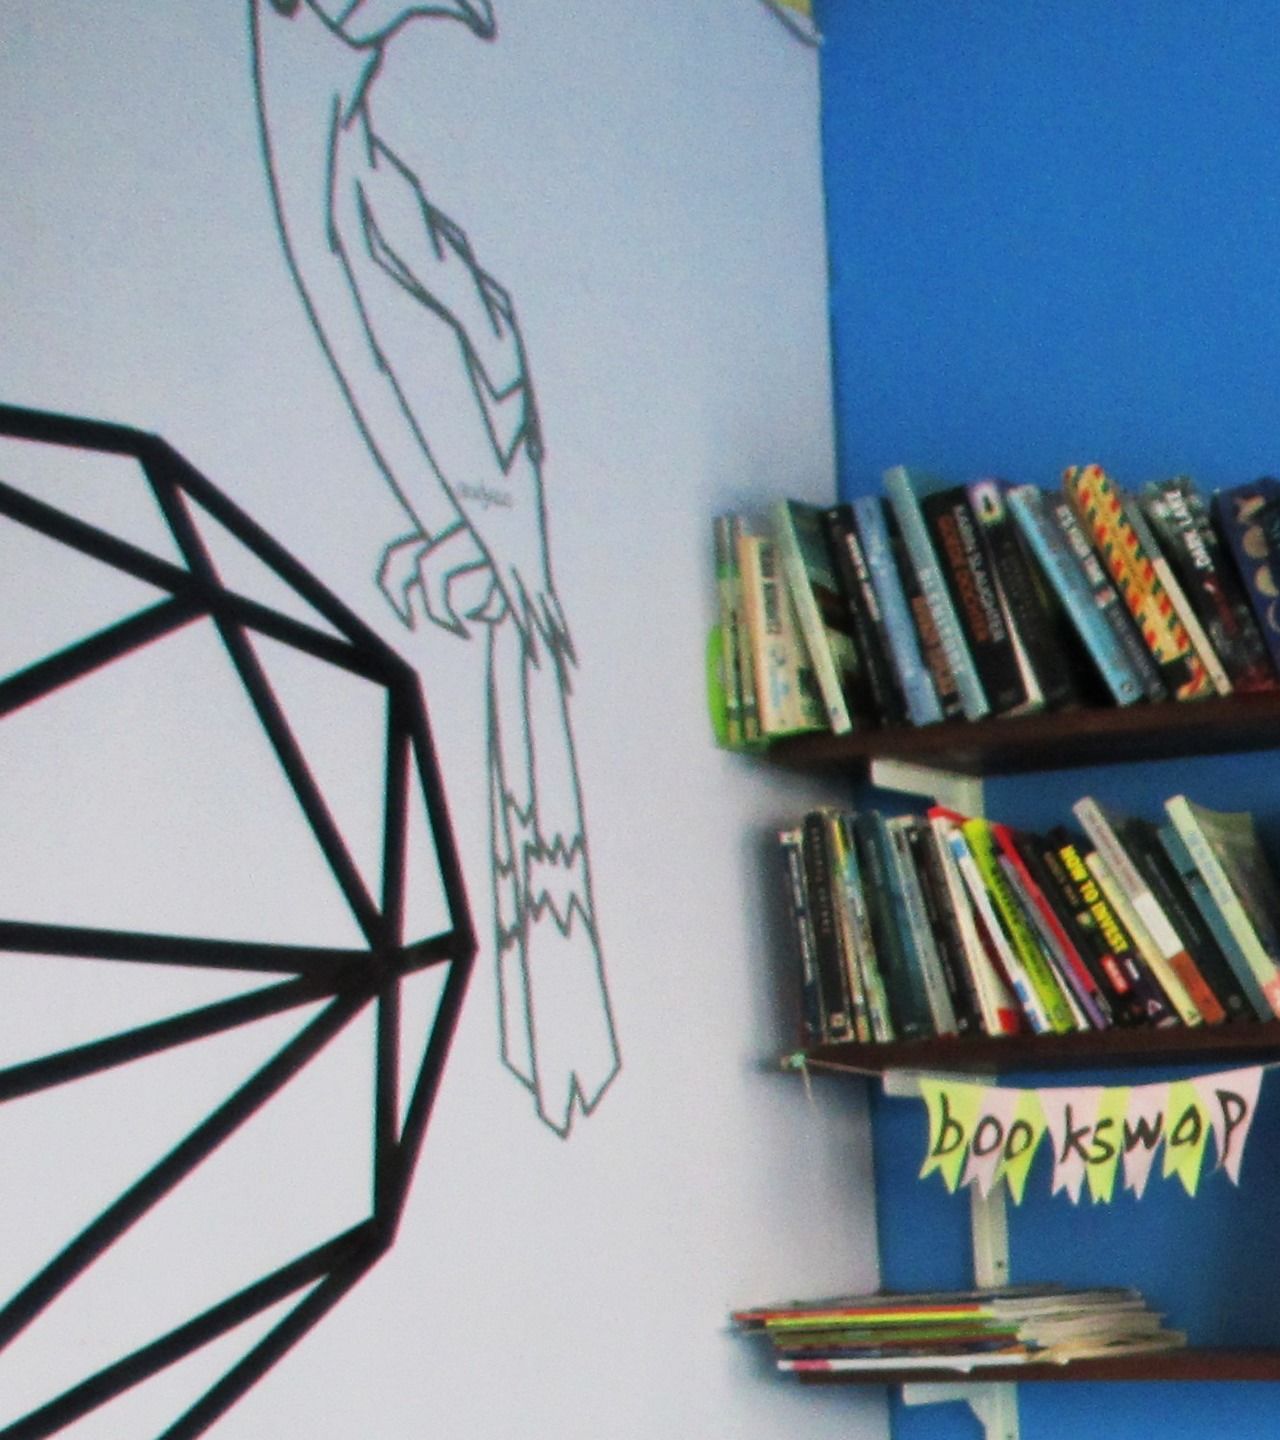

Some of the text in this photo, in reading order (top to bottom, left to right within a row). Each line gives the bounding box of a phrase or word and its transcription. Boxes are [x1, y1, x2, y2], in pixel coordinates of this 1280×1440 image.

[1056, 842, 1090, 884] HOW
[1076, 878, 1101, 904] TO
[932, 1088, 1248, 1172] bookswap
